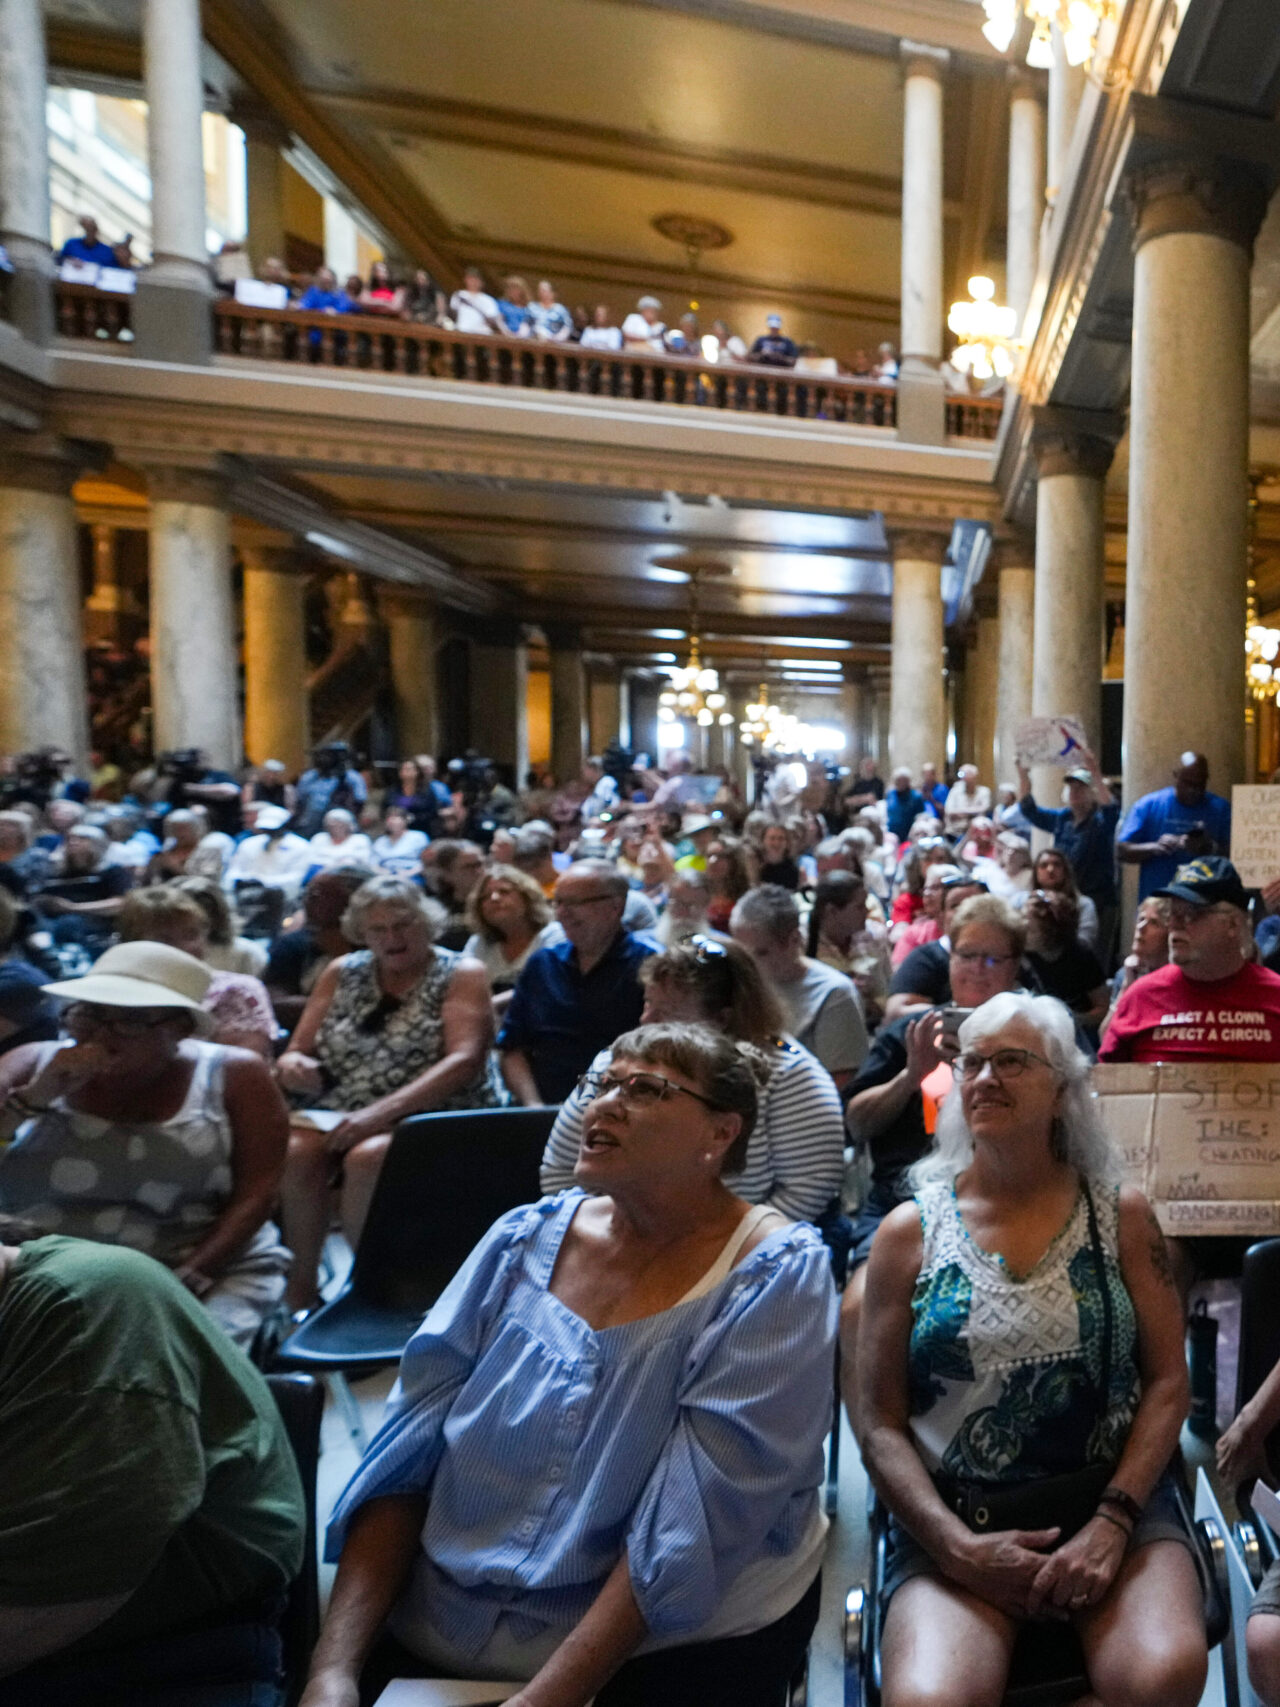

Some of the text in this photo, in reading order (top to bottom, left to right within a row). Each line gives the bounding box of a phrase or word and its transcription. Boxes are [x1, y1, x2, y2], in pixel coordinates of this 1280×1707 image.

[1160, 1010, 1266, 1025] ELECT A CLOWN
[1152, 1026, 1272, 1043] EXPECT A CIRCUS
